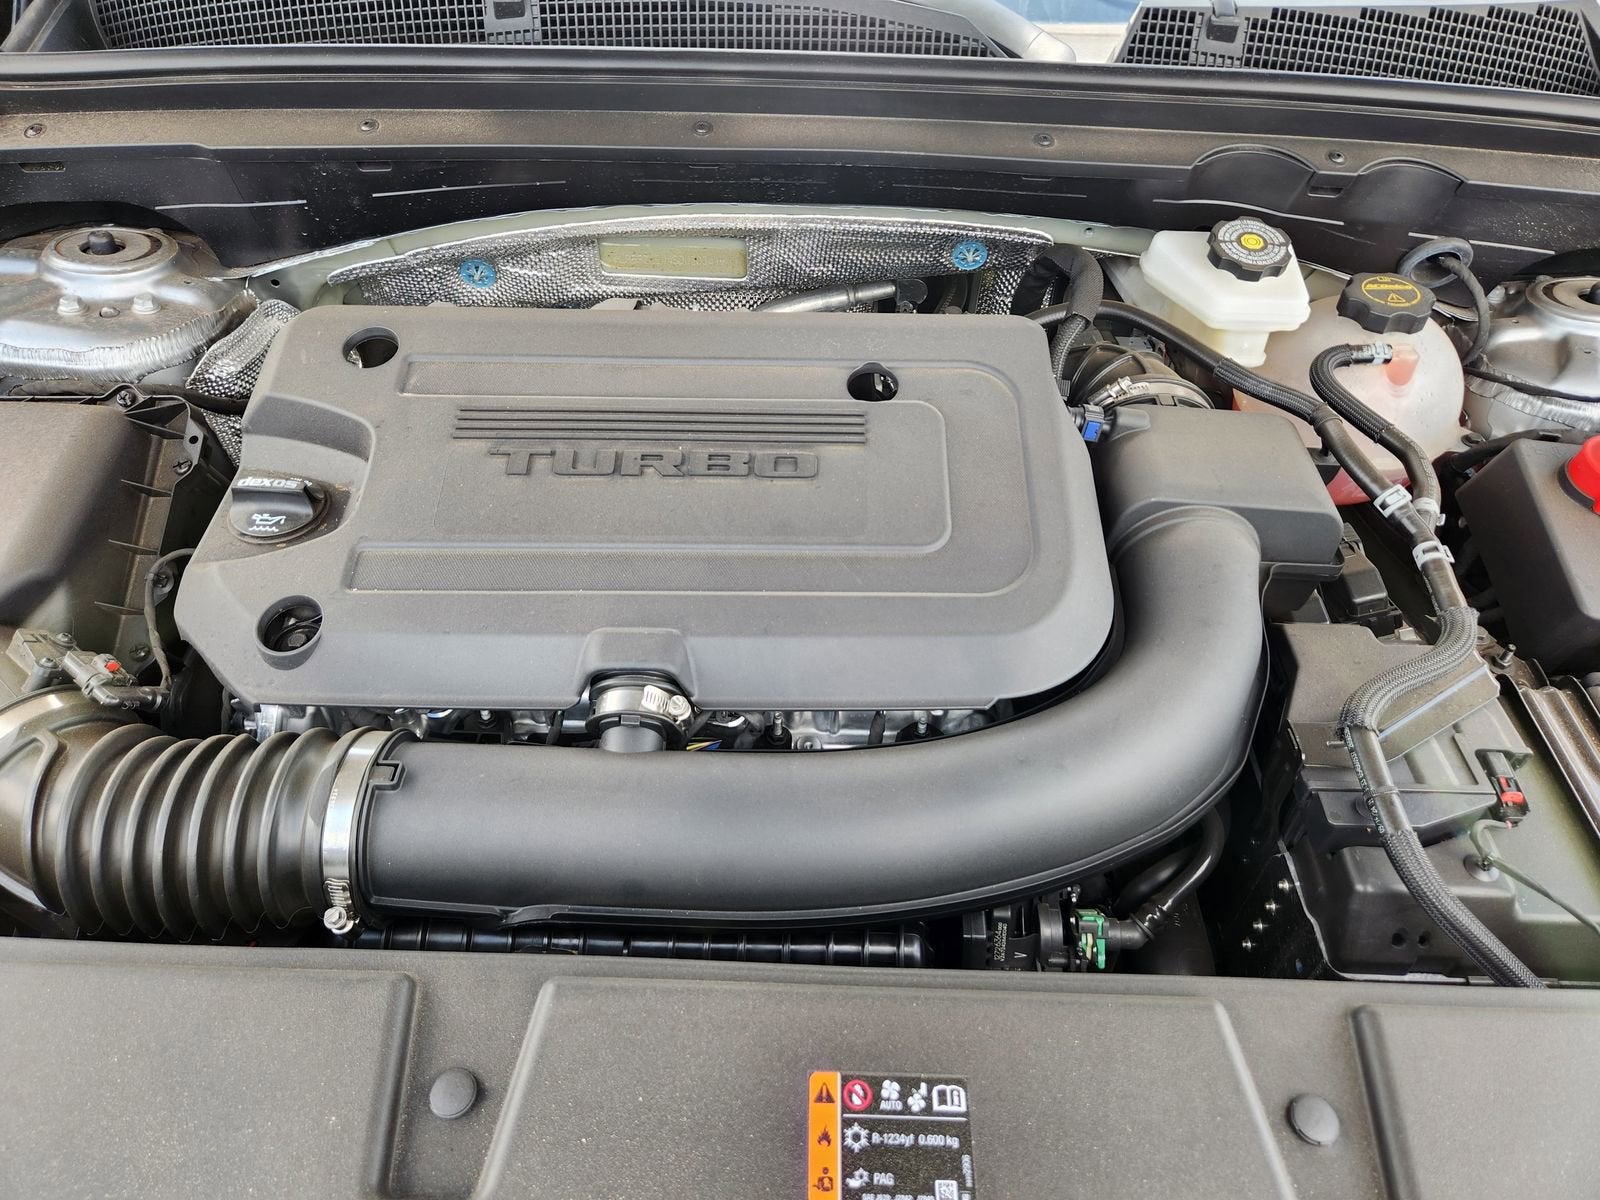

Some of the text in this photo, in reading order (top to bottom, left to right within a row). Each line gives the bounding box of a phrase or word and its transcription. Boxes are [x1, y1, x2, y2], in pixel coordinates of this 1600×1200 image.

[488, 449, 818, 478] TURBO
[237, 476, 297, 488] dexos
[880, 1100, 903, 1111] AUTO
[872, 1132, 960, 1149] R-1234yf 0.600 kg
[873, 1172, 895, 1185] PAG
